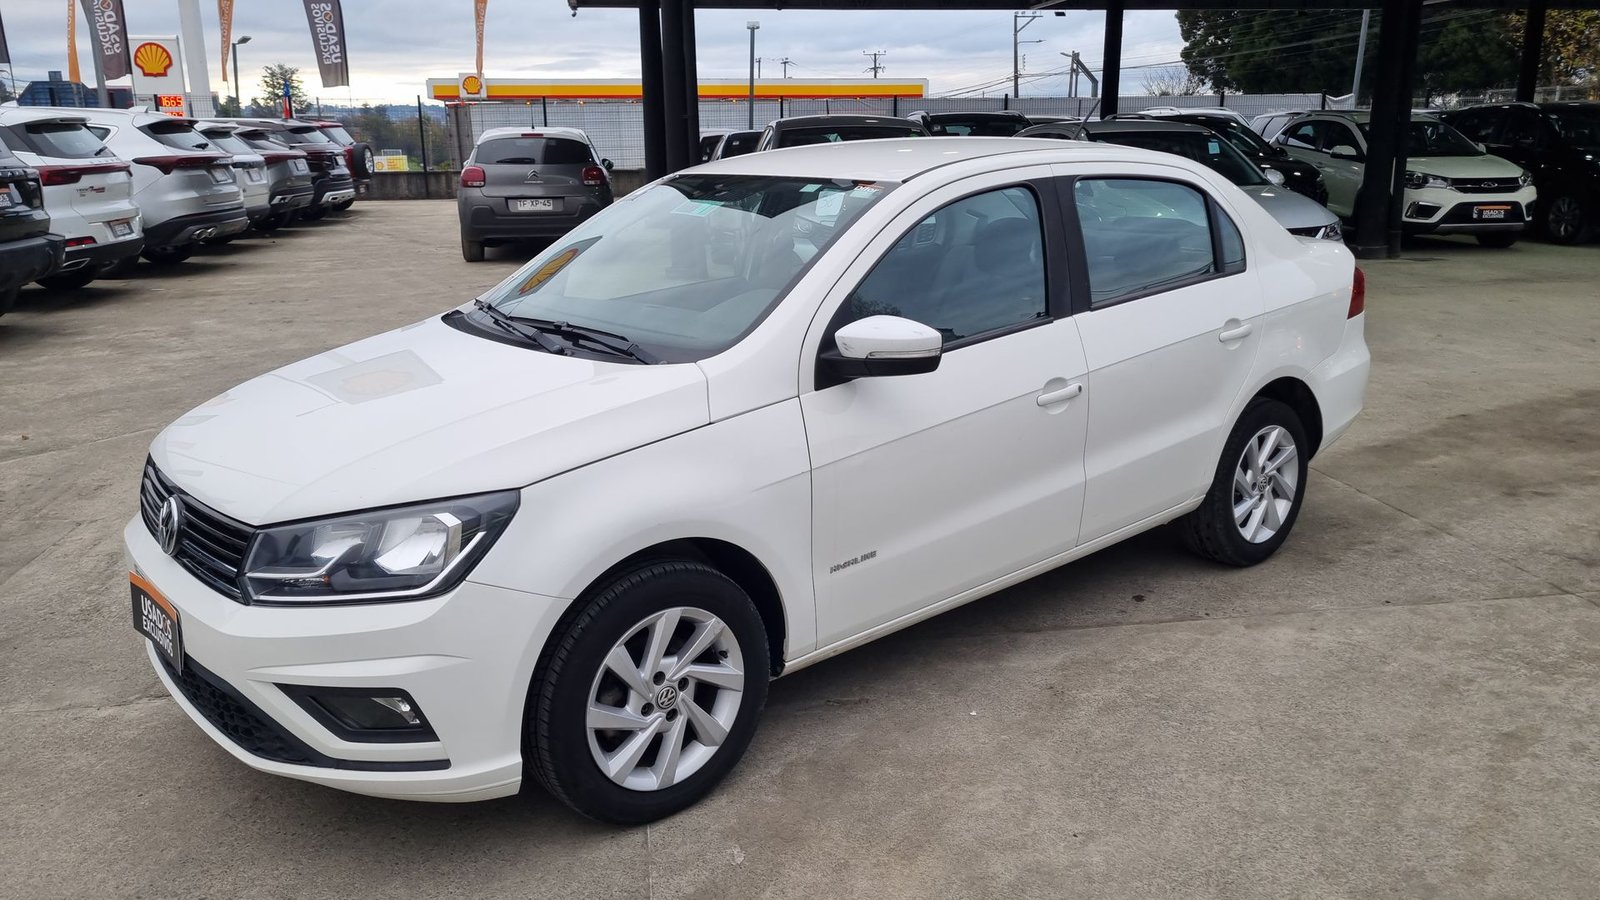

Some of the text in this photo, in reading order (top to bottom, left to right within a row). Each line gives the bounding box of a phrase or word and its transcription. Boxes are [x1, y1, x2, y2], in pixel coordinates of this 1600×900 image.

[161, 96, 184, 107] 1665
[141, 594, 172, 640] USADOS
[142, 615, 174, 657] EXCLUSIVOS
